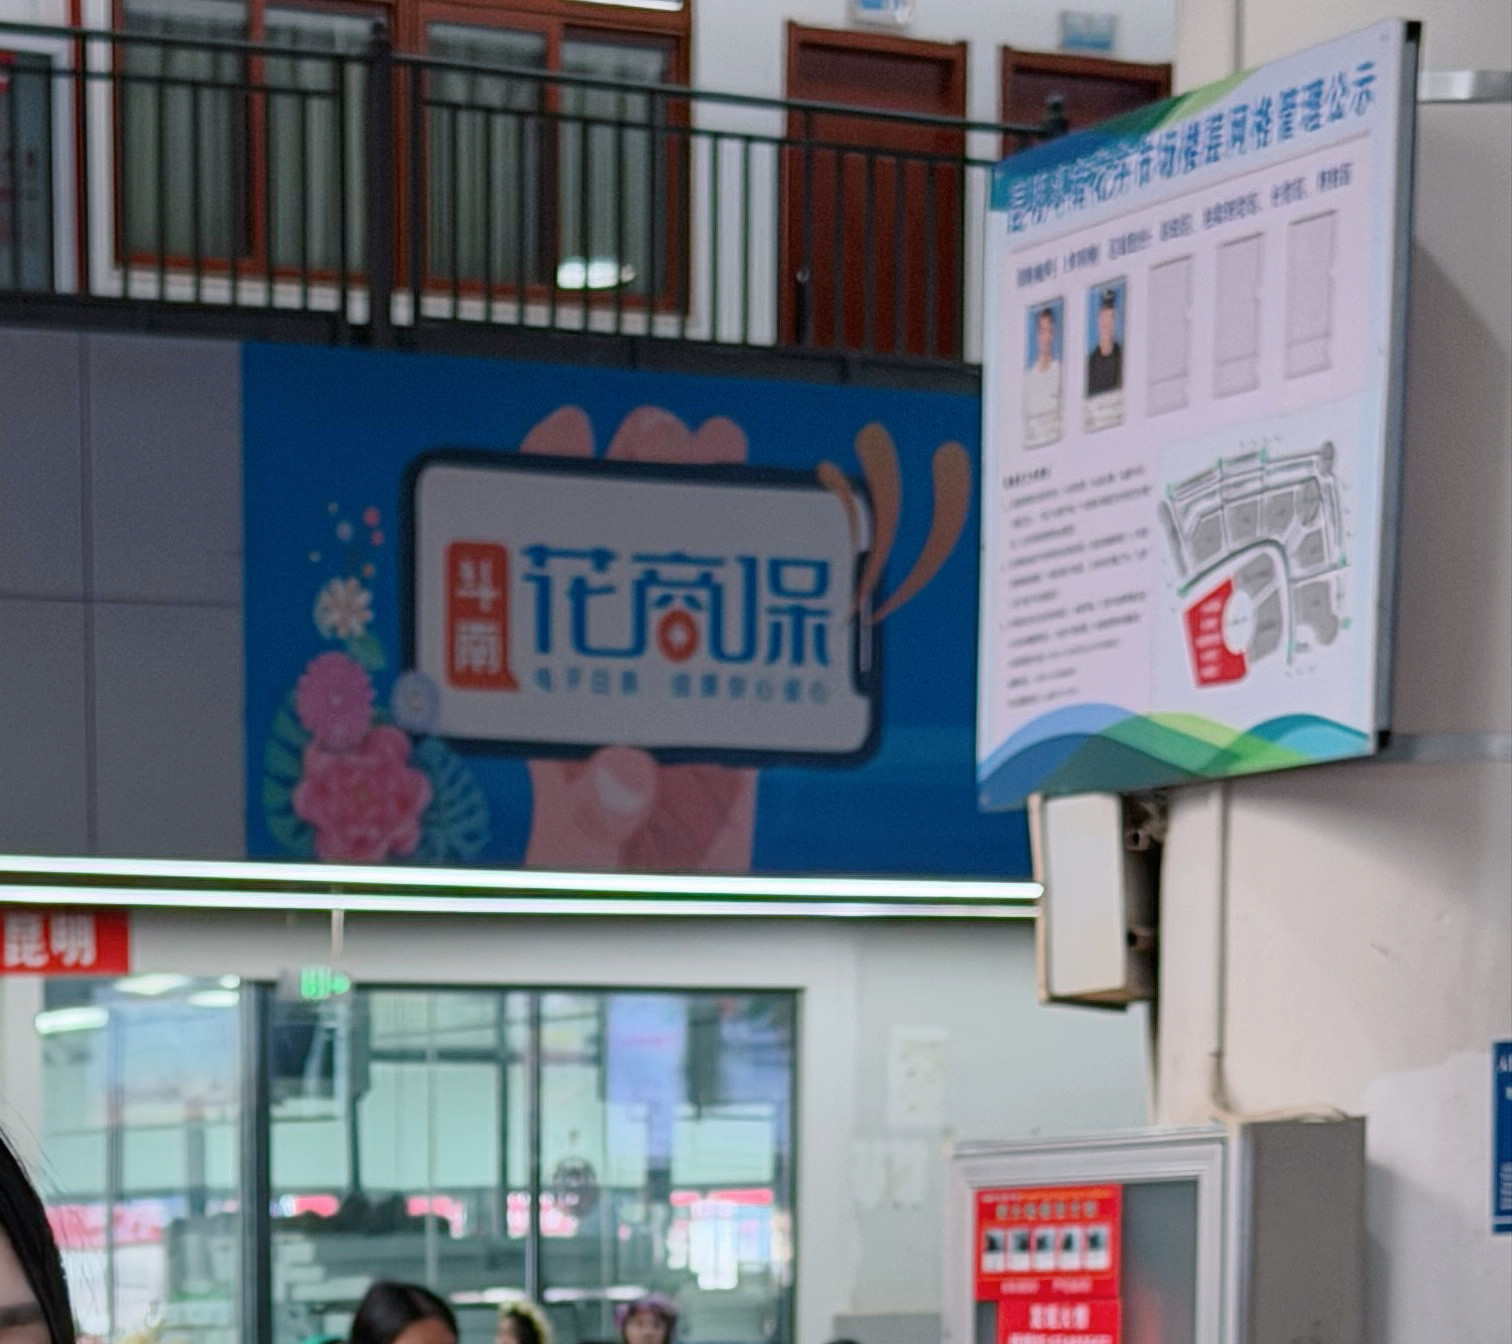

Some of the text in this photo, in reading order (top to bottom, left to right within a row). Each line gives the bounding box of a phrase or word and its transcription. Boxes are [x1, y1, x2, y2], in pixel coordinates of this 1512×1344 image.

[454, 558, 502, 676] 斗南
[519, 543, 832, 667] 花商保
[4, 912, 97, 968] 昆明
